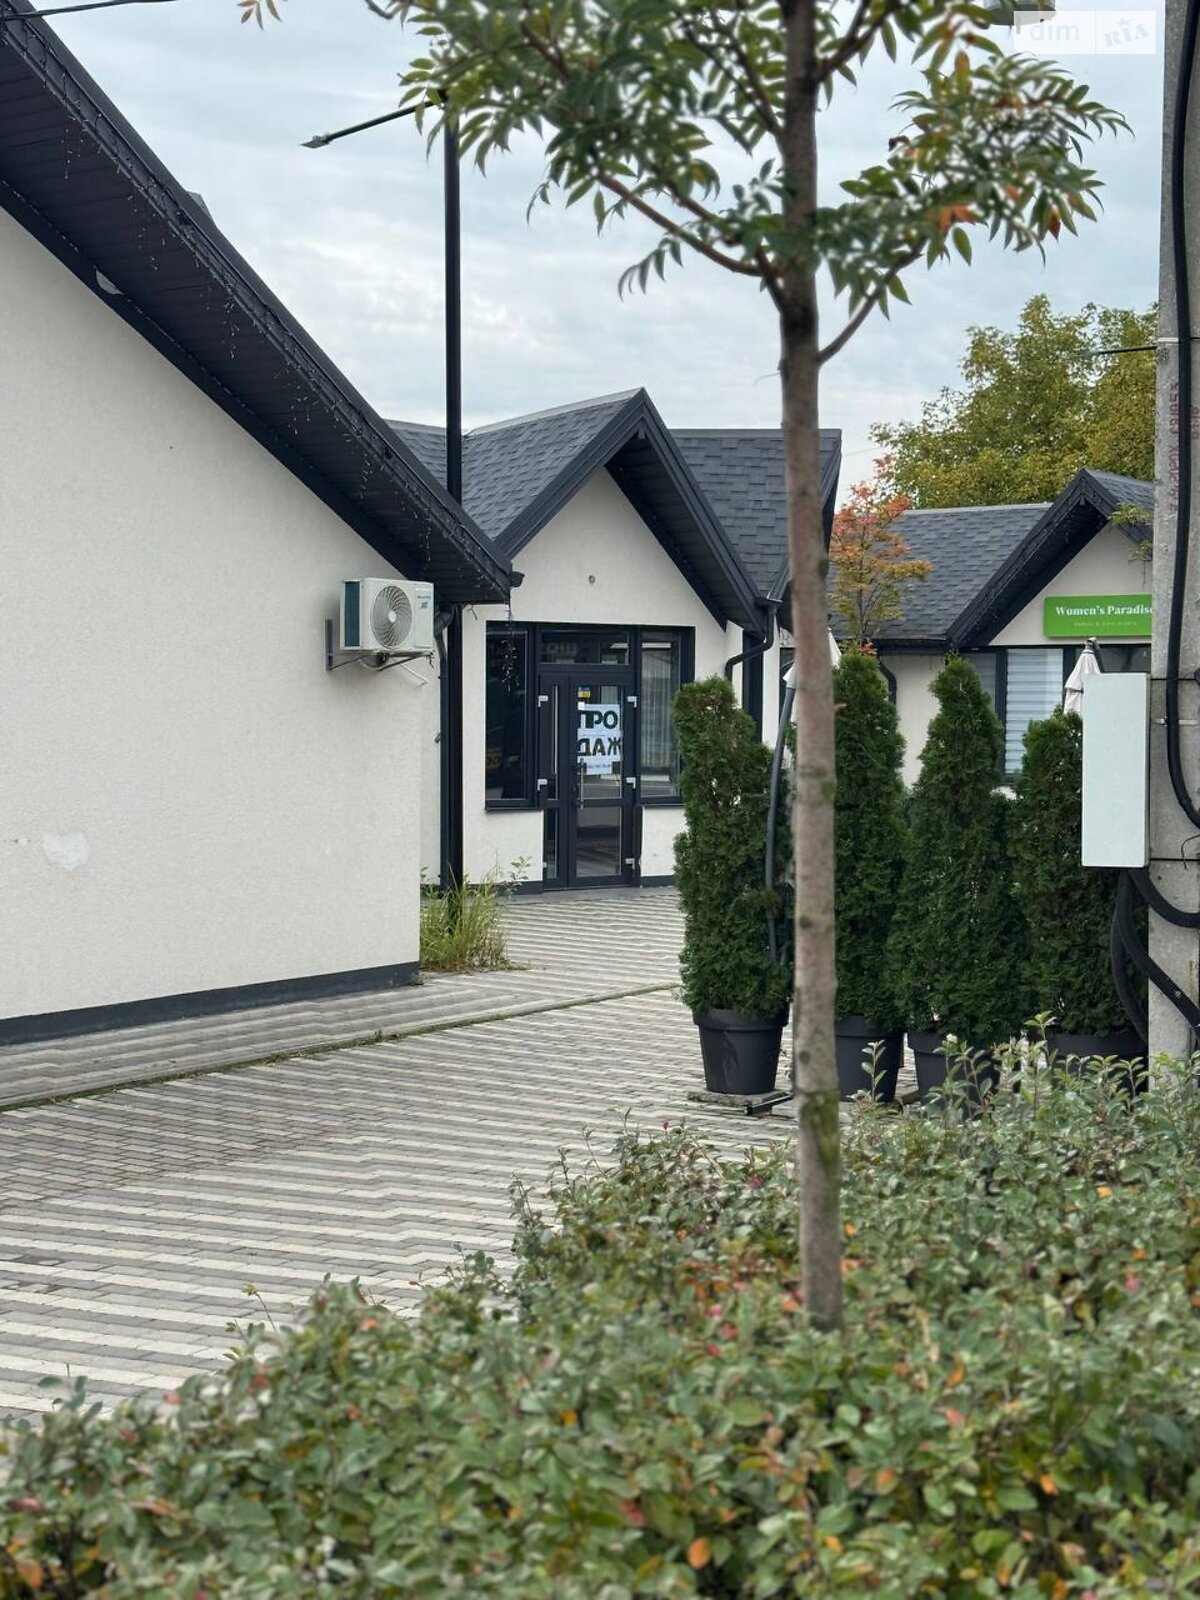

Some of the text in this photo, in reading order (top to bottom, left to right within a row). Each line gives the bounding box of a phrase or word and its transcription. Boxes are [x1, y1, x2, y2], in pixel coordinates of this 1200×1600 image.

[1056, 605, 1105, 616] Women's
[578, 710, 618, 730] ПРО
[577, 737, 621, 757] ДАЖ
